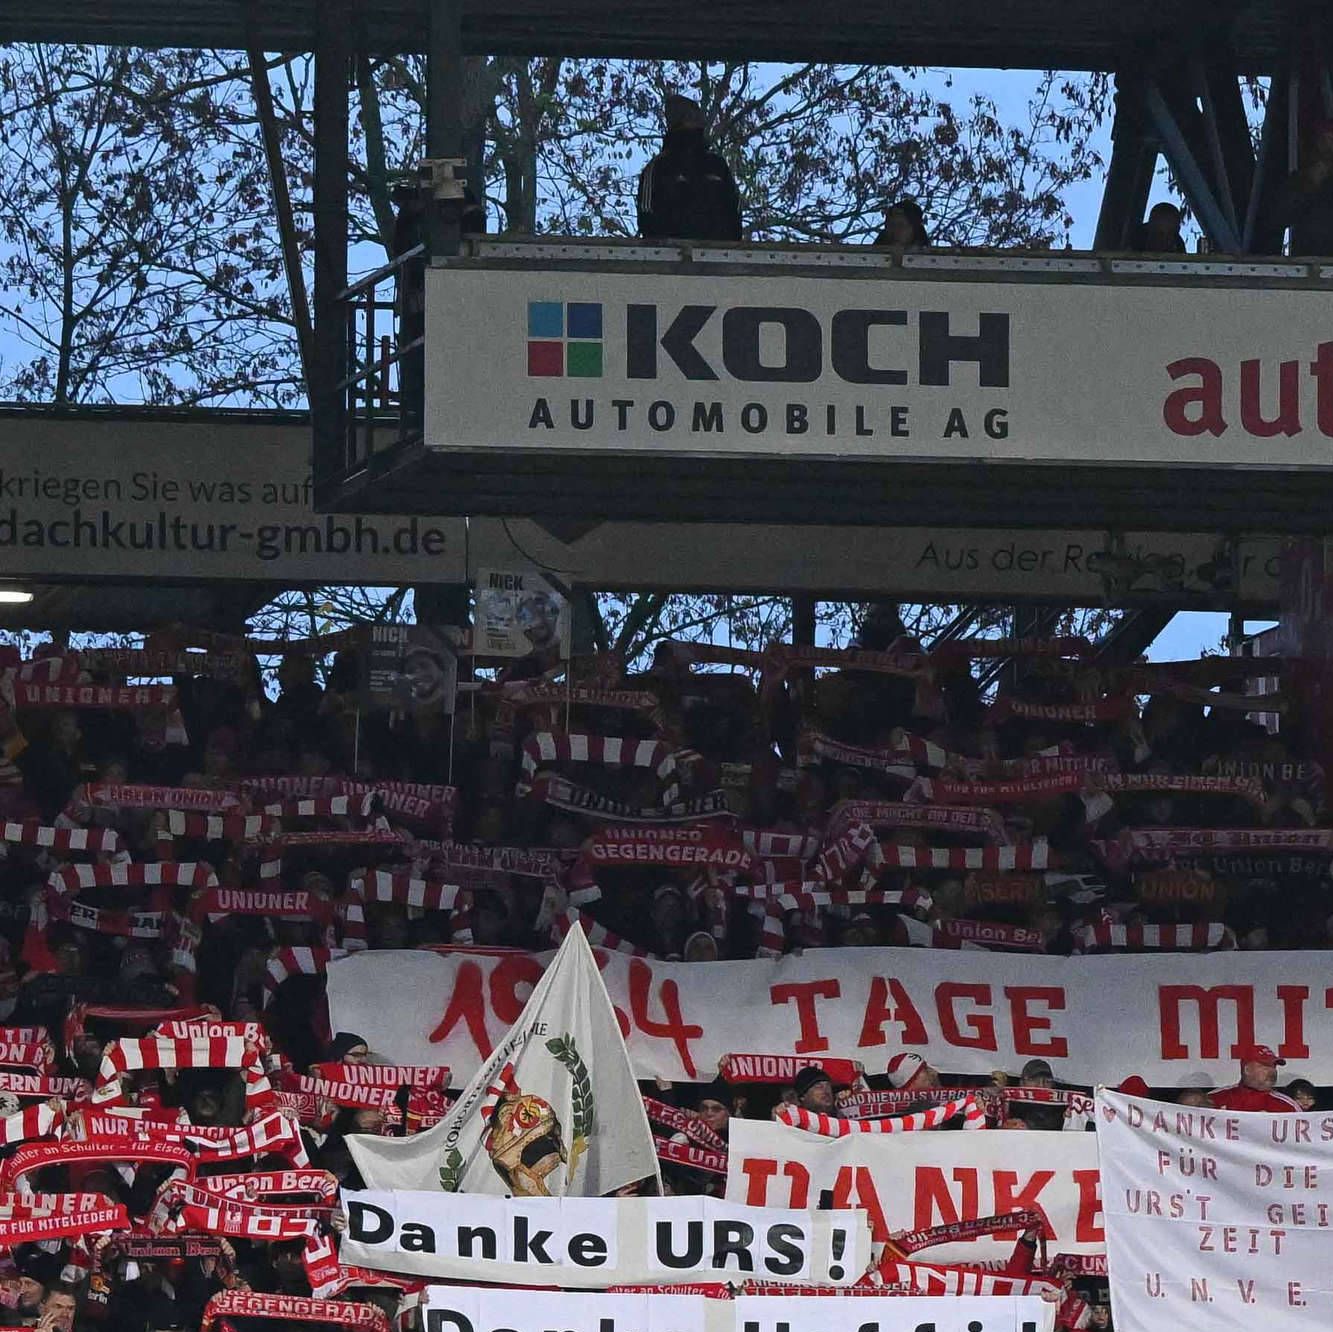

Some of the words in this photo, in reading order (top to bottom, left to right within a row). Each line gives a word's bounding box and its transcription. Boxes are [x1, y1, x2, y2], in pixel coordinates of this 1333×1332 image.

[626, 301, 1011, 388] KOCH
[528, 398, 911, 437] AUTOMOBILE
[944, 408, 1010, 440] AG
[131, 472, 180, 501] Sie
[189, 482, 252, 505] was
[915, 541, 979, 571] Aus
[991, 543, 1051, 573] der
[217, 890, 308, 911] UNIONER
[173, 1020, 236, 1039] Union
[429, 957, 704, 1081] 194
[770, 977, 1068, 1058] TAGE
[344, 1064, 442, 1085] UNIONER
[301, 1076, 396, 1106] UNIONER
[1128, 1104, 1239, 1141] DANKE
[1157, 1149, 1219, 1181] FÜR
[1255, 1164, 1319, 1189] DIE
[10, 1218, 37, 1234] FÜR
[41, 1210, 120, 1233] MITGLIEDER!
[347, 1202, 608, 1266] Danke
[657, 1217, 847, 1280] URS!
[1199, 1226, 1286, 1255] ZEIT
